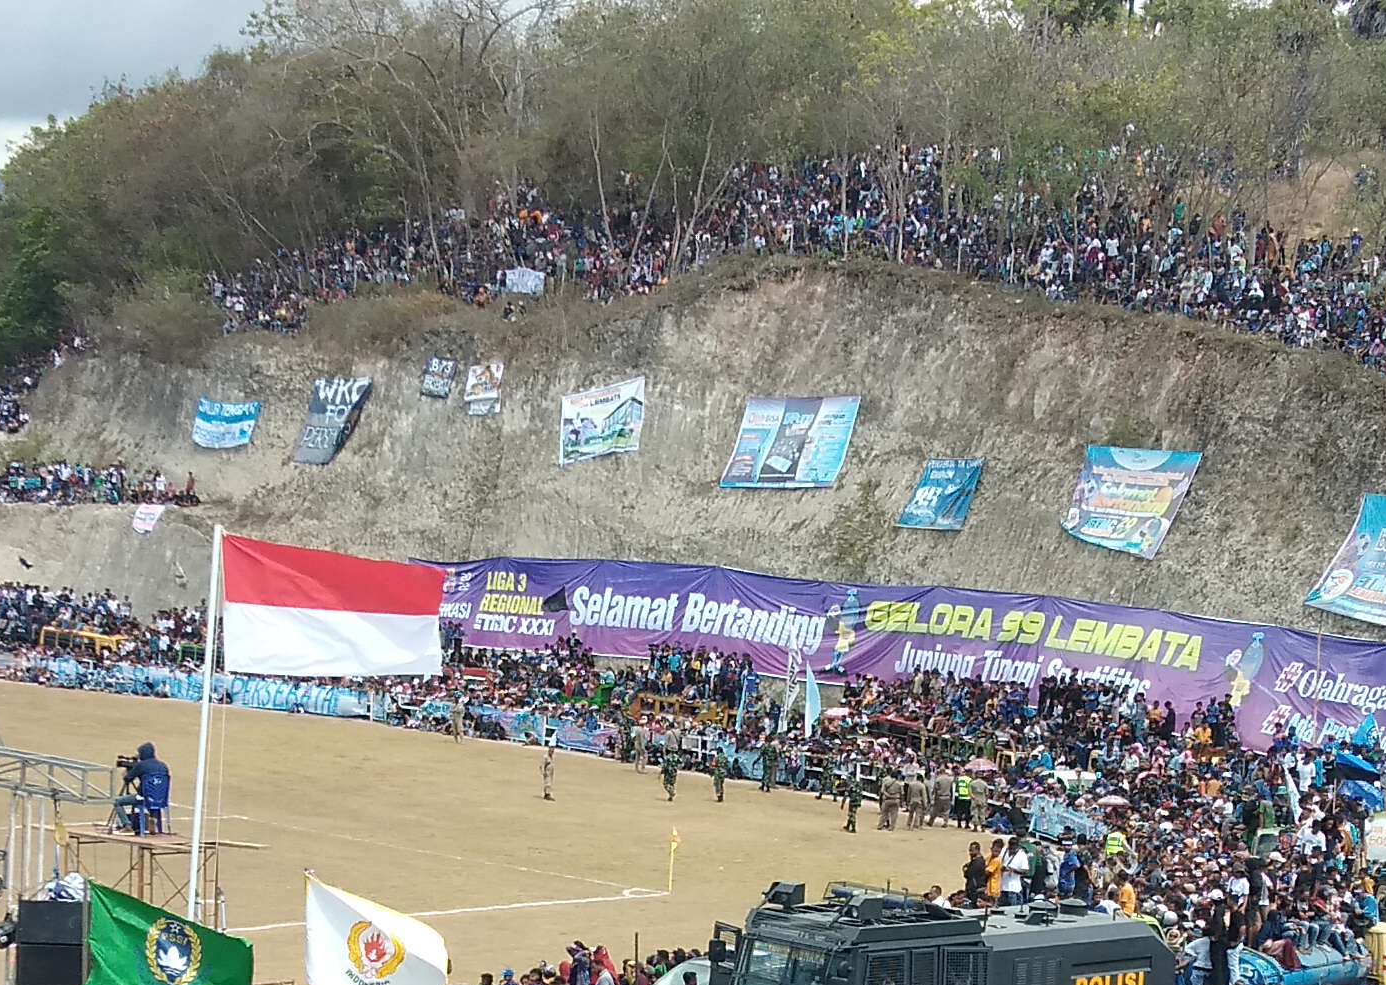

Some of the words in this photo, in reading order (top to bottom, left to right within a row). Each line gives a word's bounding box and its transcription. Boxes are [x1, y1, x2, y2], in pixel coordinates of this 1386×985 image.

[486, 571, 515, 592] LIGA
[517, 572, 528, 593] 3
[479, 593, 545, 616] REGIONAL
[517, 616, 556, 637] XXXI
[570, 585, 674, 631] Selamat
[681, 593, 827, 652] Bertanding
[864, 600, 993, 642] GELORA
[999, 610, 1046, 645] 99
[1043, 615, 1204, 672] LEMBATA
